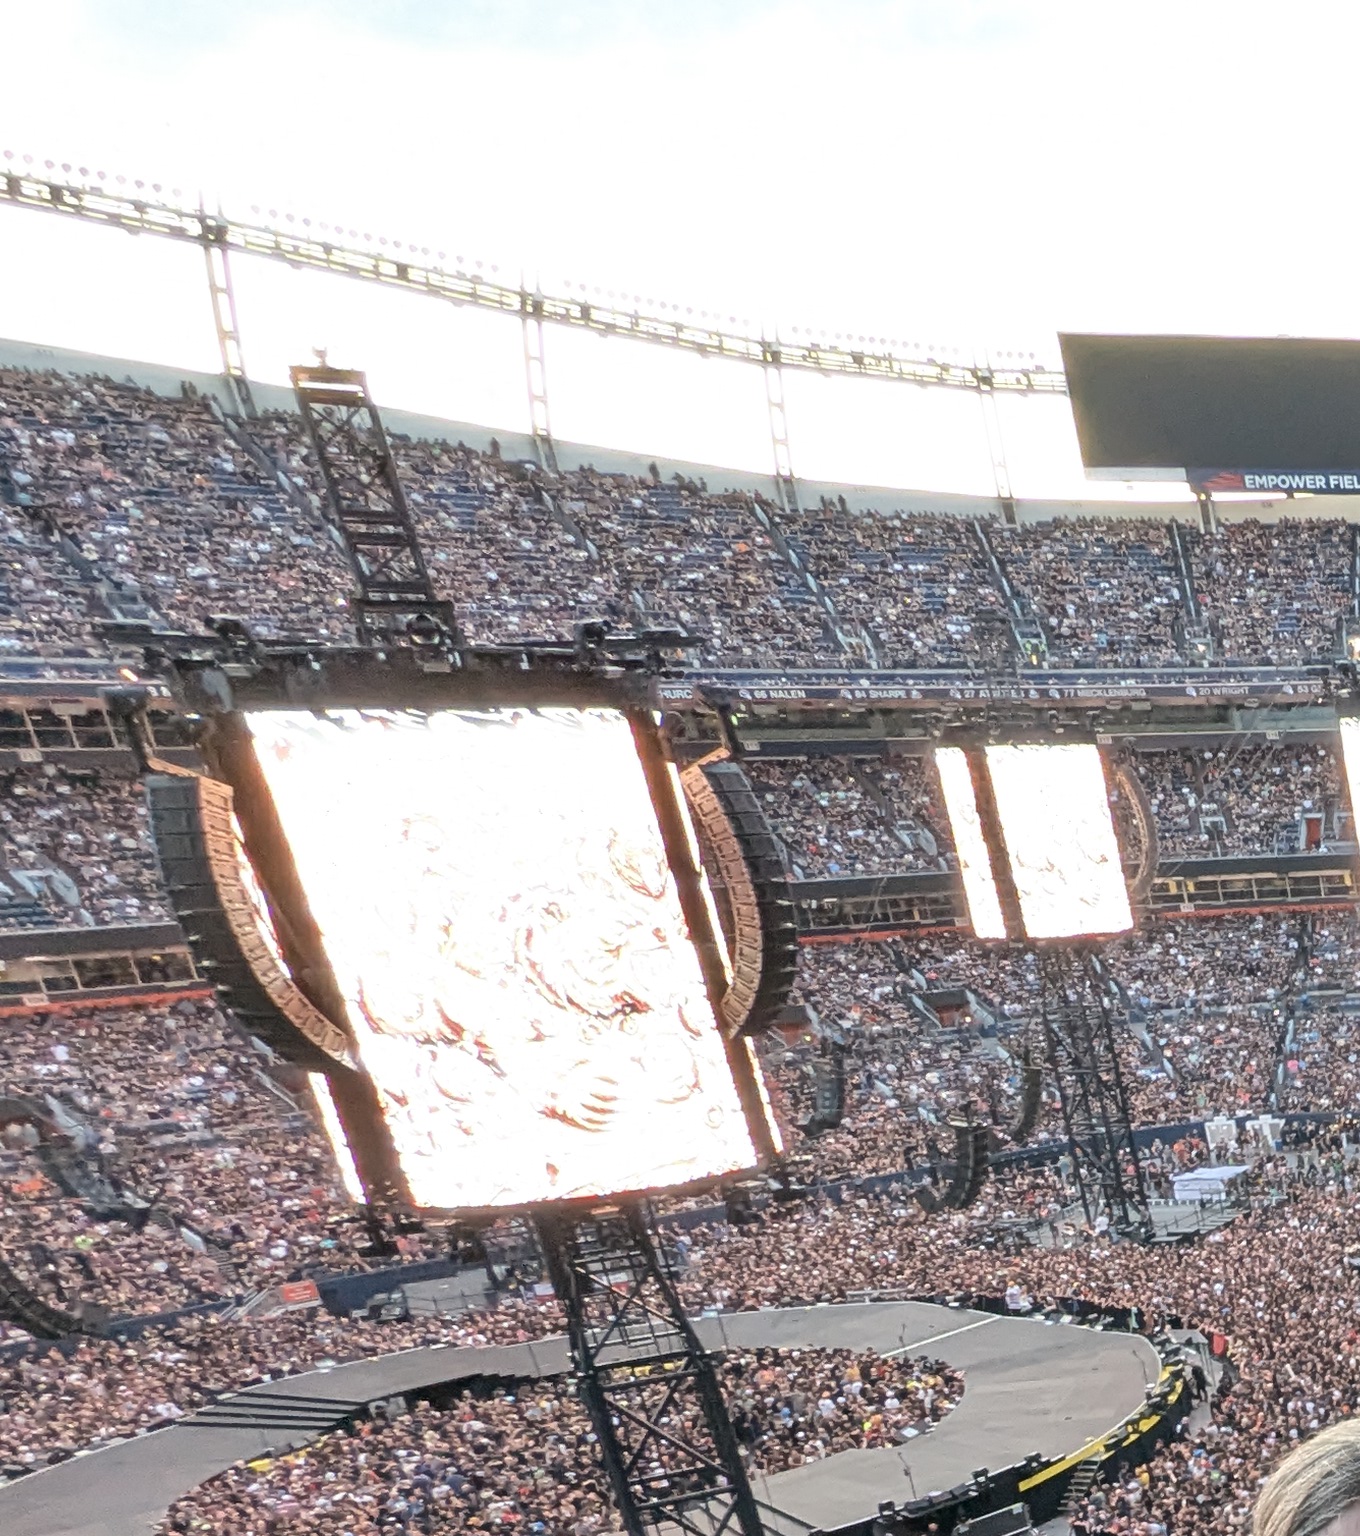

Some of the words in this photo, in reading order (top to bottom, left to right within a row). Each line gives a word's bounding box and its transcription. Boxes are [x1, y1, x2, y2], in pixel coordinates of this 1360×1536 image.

[1244, 474, 1326, 489] EMPOWER
[769, 689, 807, 699] NALEN
[1063, 689, 1076, 699] 77
[1198, 687, 1211, 697] 20
[1212, 686, 1249, 697] WRIGHT
